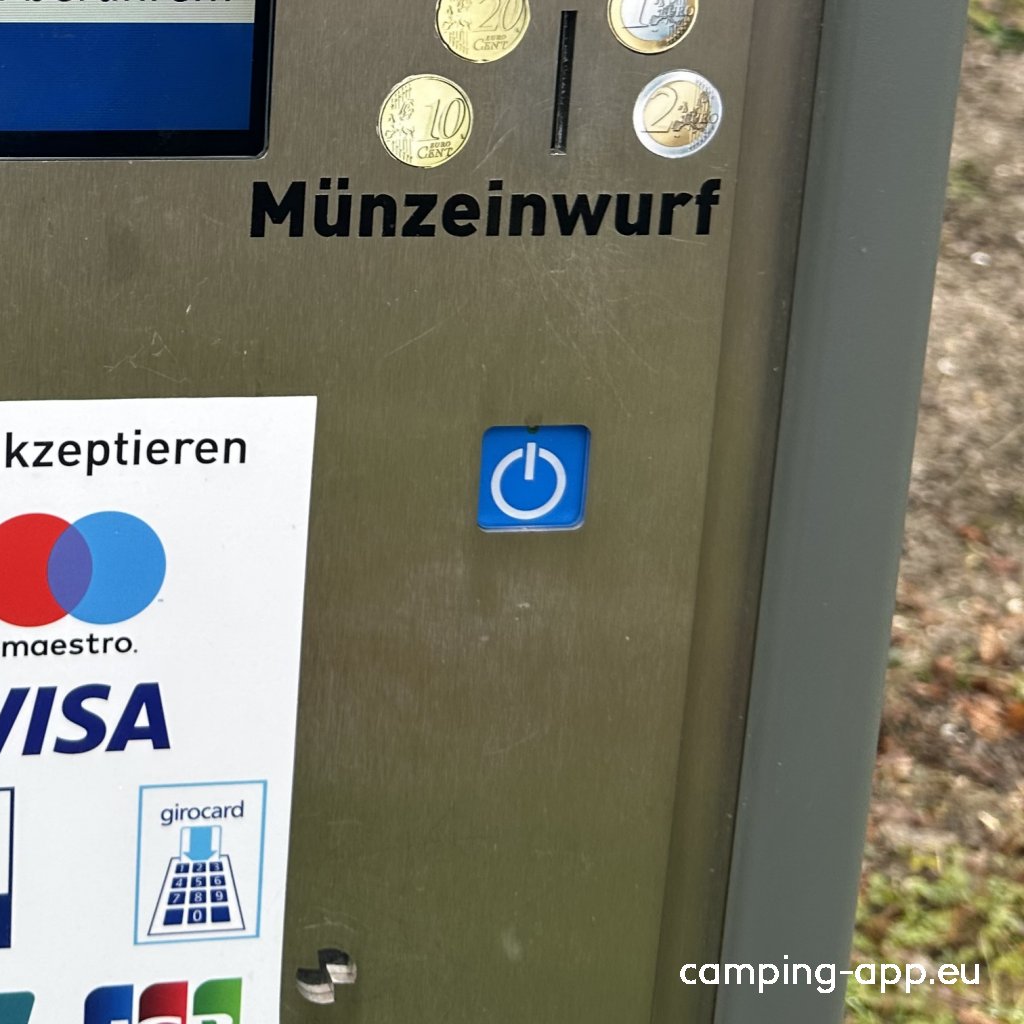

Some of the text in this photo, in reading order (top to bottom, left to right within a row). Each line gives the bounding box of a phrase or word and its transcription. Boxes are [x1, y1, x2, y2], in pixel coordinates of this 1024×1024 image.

[418, 97, 466, 142] 10
[640, 86, 677, 133] 2
[430, 140, 451, 148] EURO
[249, 177, 722, 238] Münzeinwurf
[160, 799, 245, 827] girocard
[176, 877, 221, 887] 4 5 6
[173, 891, 223, 903] 7 8 9
[193, 910, 202, 921] 0
